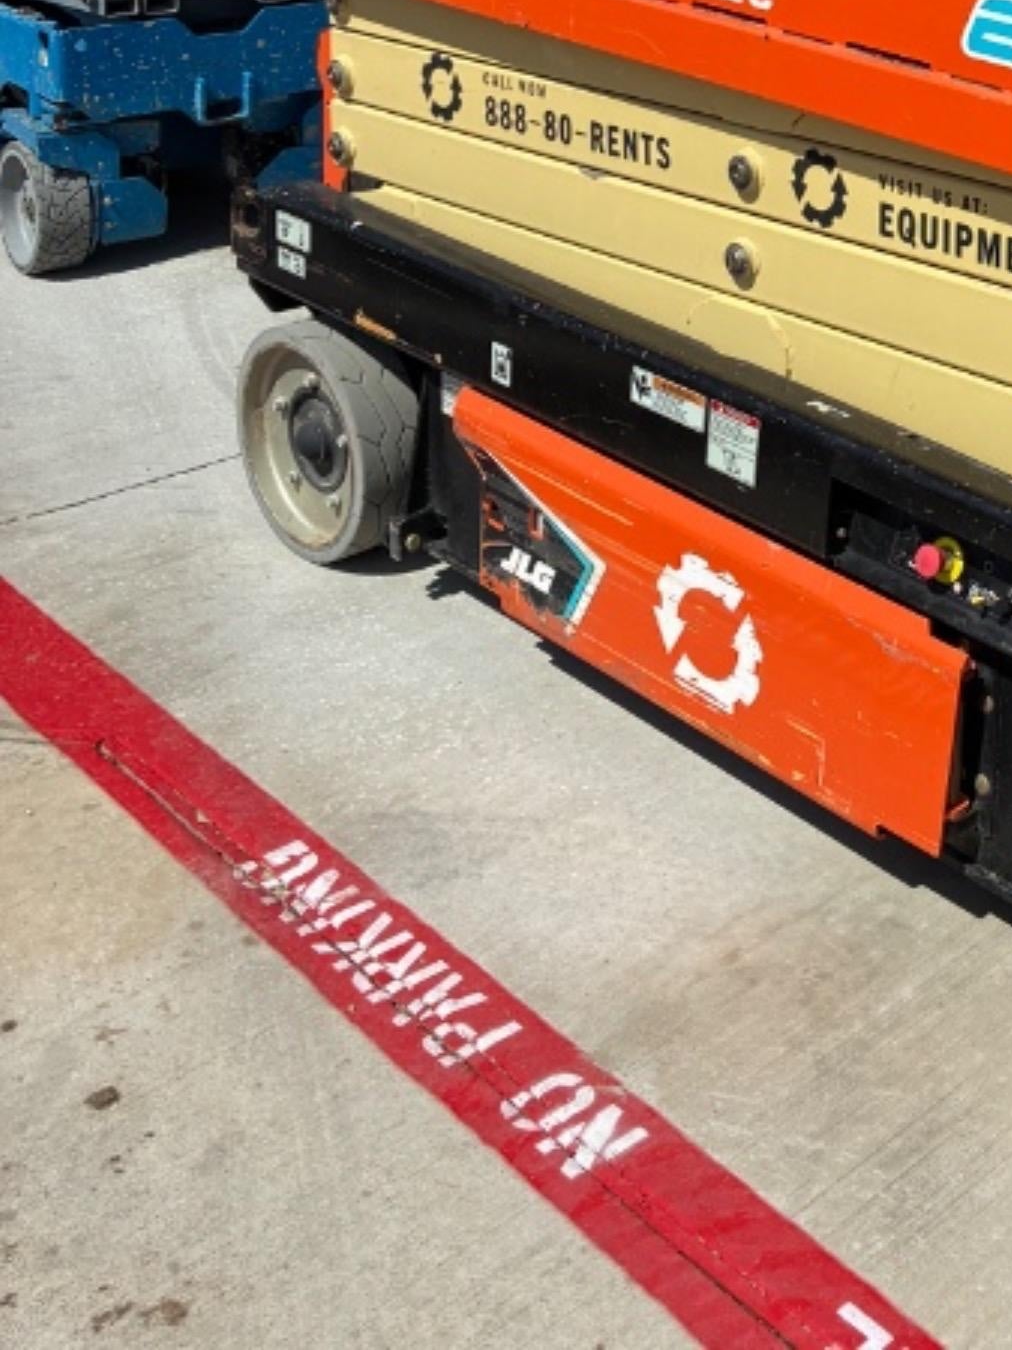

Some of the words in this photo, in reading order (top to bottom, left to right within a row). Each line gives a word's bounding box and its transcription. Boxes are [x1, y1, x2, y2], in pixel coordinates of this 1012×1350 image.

[484, 96, 672, 170] 888-80-RENTS
[878, 173, 922, 198] VISIT
[932, 185, 953, 208] US
[500, 547, 556, 595] JLG
[232, 839, 523, 1068] PARKING
[501, 1072, 648, 1180] NO
